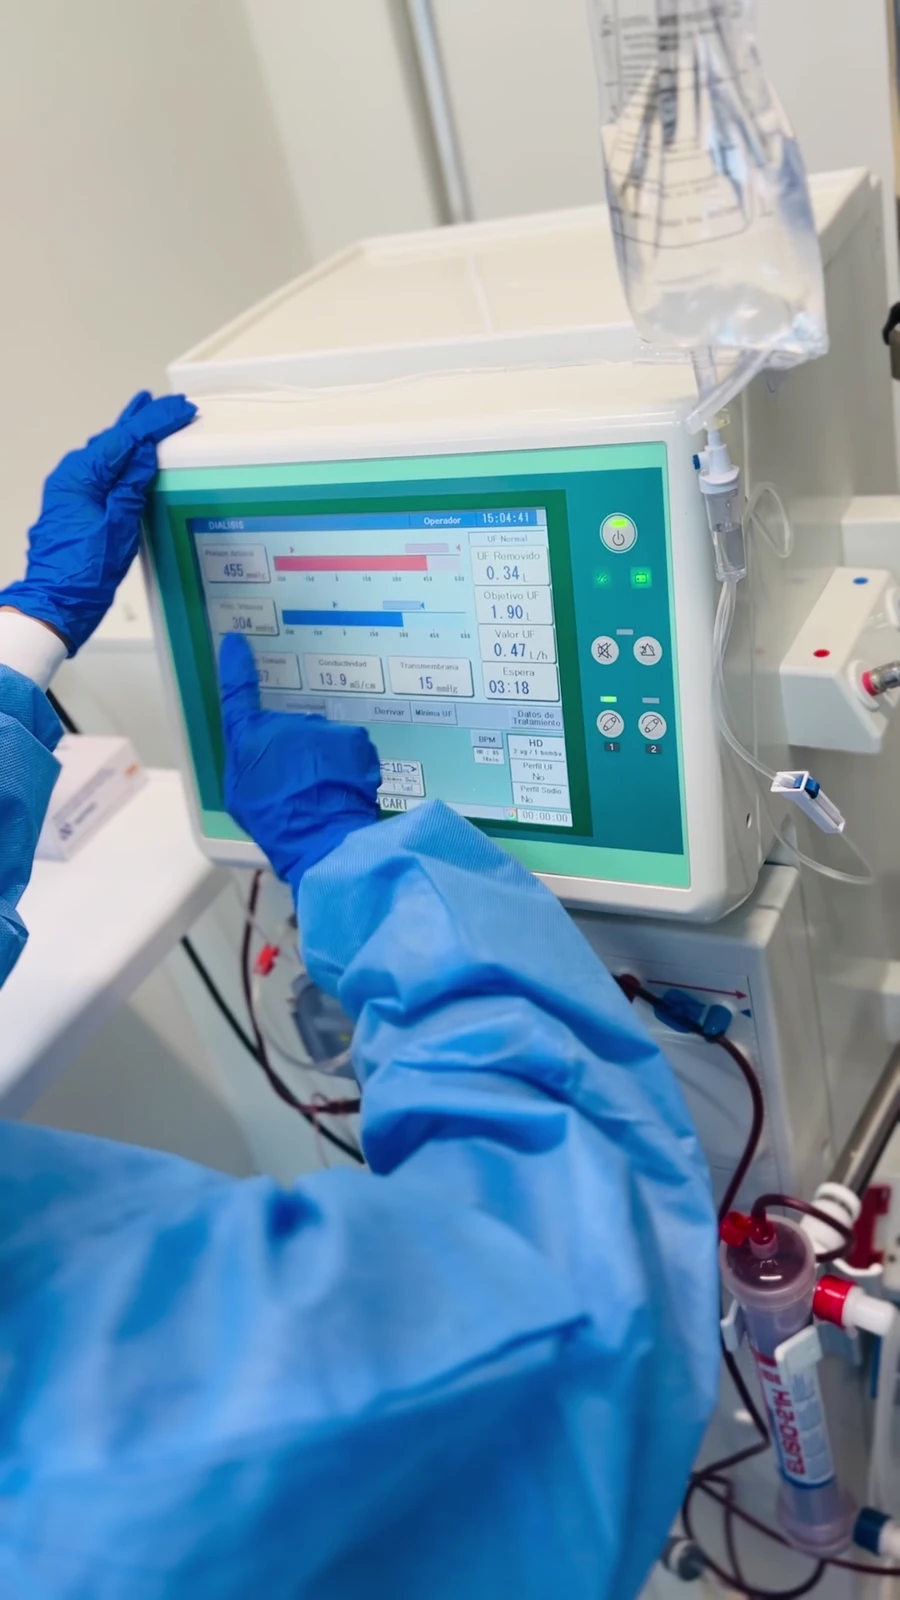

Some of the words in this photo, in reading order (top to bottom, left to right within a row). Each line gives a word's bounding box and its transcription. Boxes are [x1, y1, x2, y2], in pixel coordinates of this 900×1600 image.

[424, 516, 461, 526] Operador
[482, 512, 529, 524] 15:04:41
[477, 552, 489, 560] UF
[494, 551, 540, 560] Removido
[223, 564, 244, 577] 455
[486, 565, 520, 580] 0.34
[484, 590, 524, 601] Objetivo
[526, 590, 540, 600] UF
[491, 604, 524, 620] 1.90
[232, 616, 252, 630] 304
[494, 630, 519, 638] Valor
[522, 630, 536, 638] UF
[494, 642, 526, 658] 0.47
[530, 650, 548, 660] L/h
[318, 659, 367, 668] Conductividad
[400, 662, 459, 670] Transmembrana
[502, 667, 535, 676] Espera
[320, 672, 347, 686] 13.9
[418, 676, 433, 690] 15
[489, 680, 530, 694] 03:18
[374, 706, 404, 716] Derivar
[518, 710, 542, 718] Datos
[544, 710, 554, 719] de
[512, 718, 561, 727] Tratamiento
[529, 739, 544, 748] HD
[610, 743, 614, 751] 1
[650, 745, 657, 754] 2
[523, 762, 542, 770] Perfil
[544, 762, 554, 770] UF
[532, 773, 545, 782] No
[520, 785, 540, 793] Perfil
[542, 786, 562, 795] Sodio
[520, 795, 534, 804] No
[522, 810, 568, 822] 00:00:00
